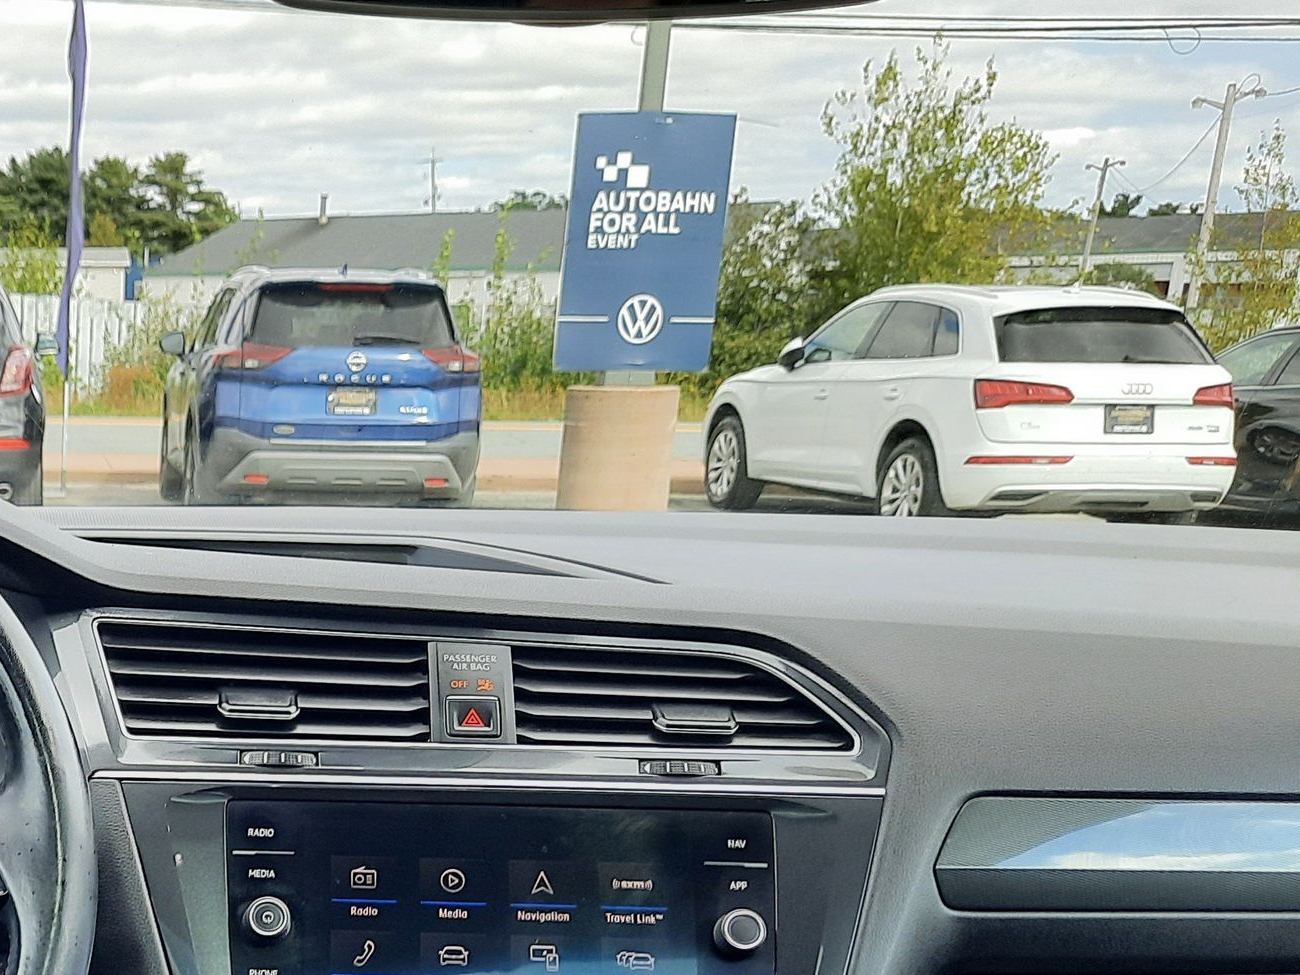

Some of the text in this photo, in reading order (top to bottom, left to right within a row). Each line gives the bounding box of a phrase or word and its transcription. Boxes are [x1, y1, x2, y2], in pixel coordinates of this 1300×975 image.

[591, 191, 716, 213] AUTOBAHN
[589, 213, 681, 234] FOR ALL
[587, 234, 641, 250] EVENT
[443, 654, 497, 663] PASSENGER
[452, 663, 490, 671] AIR BAG
[450, 680, 470, 689] OFF
[247, 828, 275, 838] RADIO
[727, 839, 747, 849] NAV
[248, 869, 276, 879] MEDIA
[730, 881, 748, 891] APP
[350, 906, 379, 917] Radio
[438, 908, 468, 919] Media
[517, 910, 570, 923] Navigation
[606, 912, 634, 924] Travel
